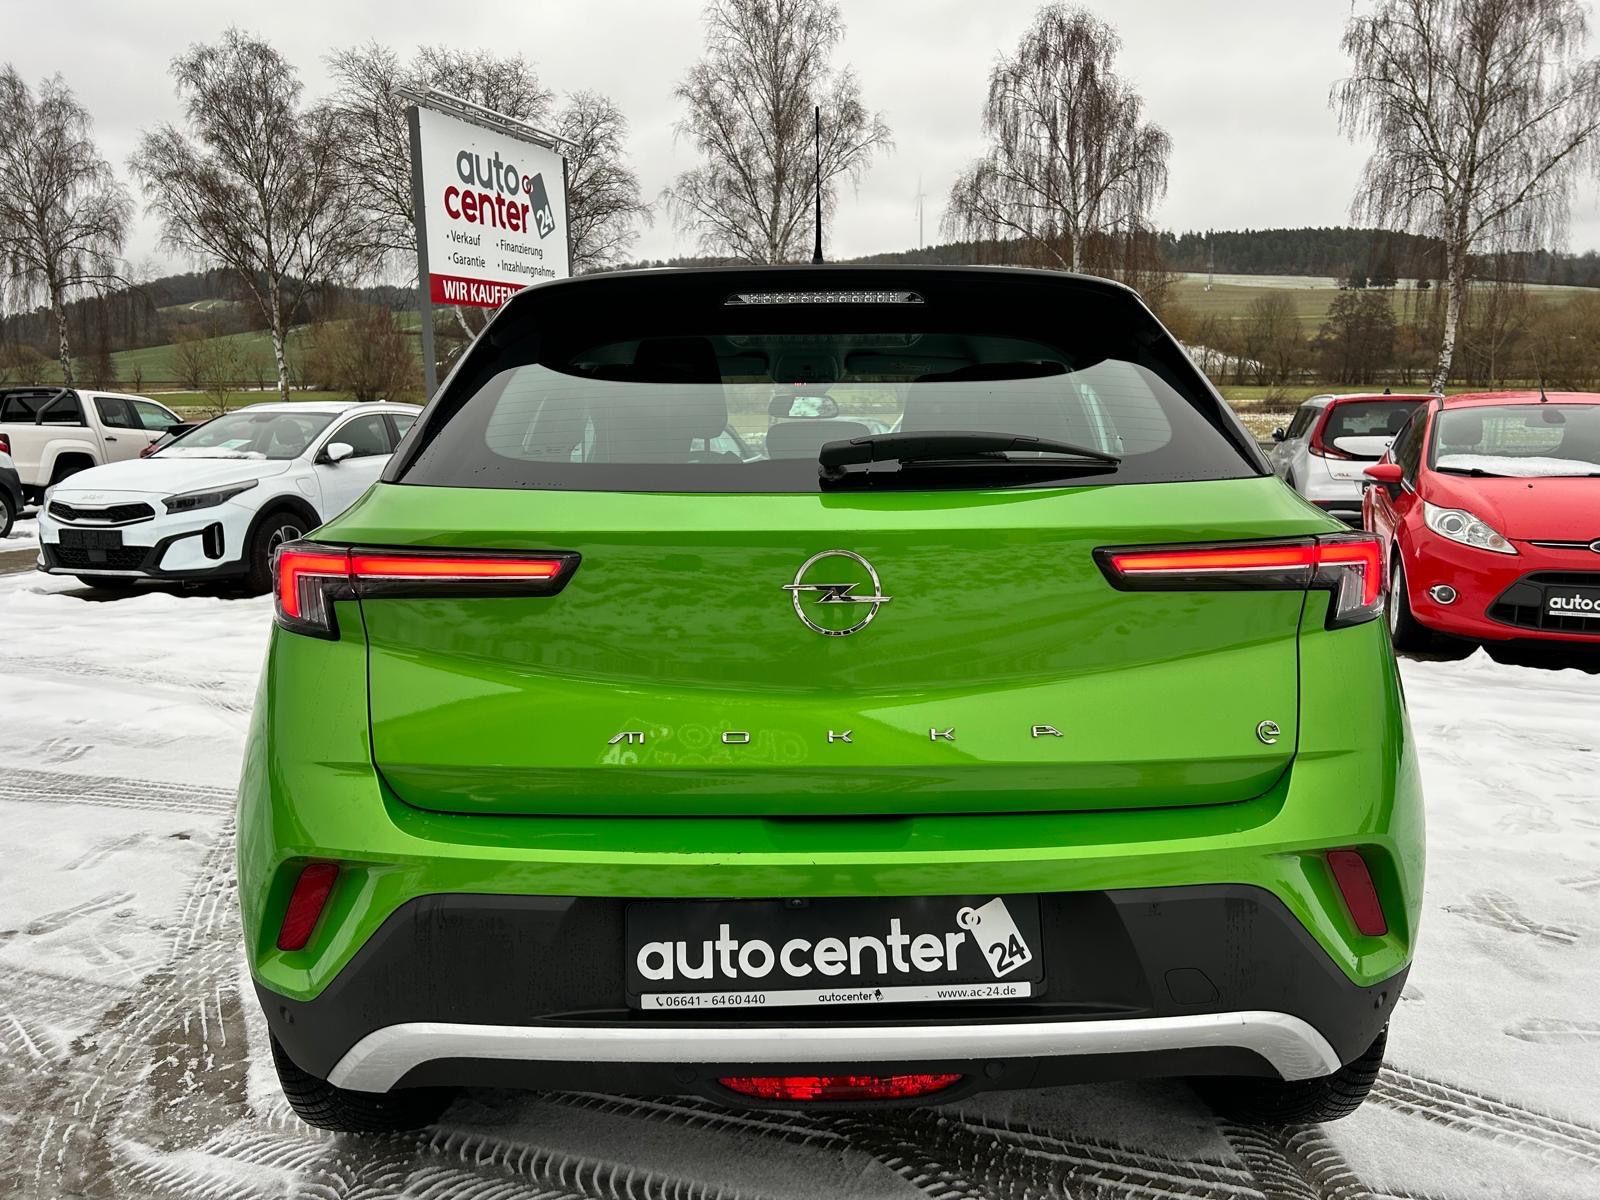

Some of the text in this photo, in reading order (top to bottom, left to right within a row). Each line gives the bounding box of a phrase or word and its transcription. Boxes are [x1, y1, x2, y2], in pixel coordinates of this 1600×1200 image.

[457, 150, 520, 196] auto
[444, 186, 529, 234] center
[536, 204, 553, 236] 24
[450, 229, 481, 247] Verkauf
[500, 239, 543, 260] Finanzierung
[453, 252, 486, 268] Garantie
[501, 259, 556, 278] Inzahlungnahme
[442, 279, 468, 301] WIR
[636, 918, 1027, 980] autocenter 24
[665, 995, 701, 1007] 06641
[818, 991, 872, 1002] autocenter
[937, 985, 1017, 998] www.ac-24.de
